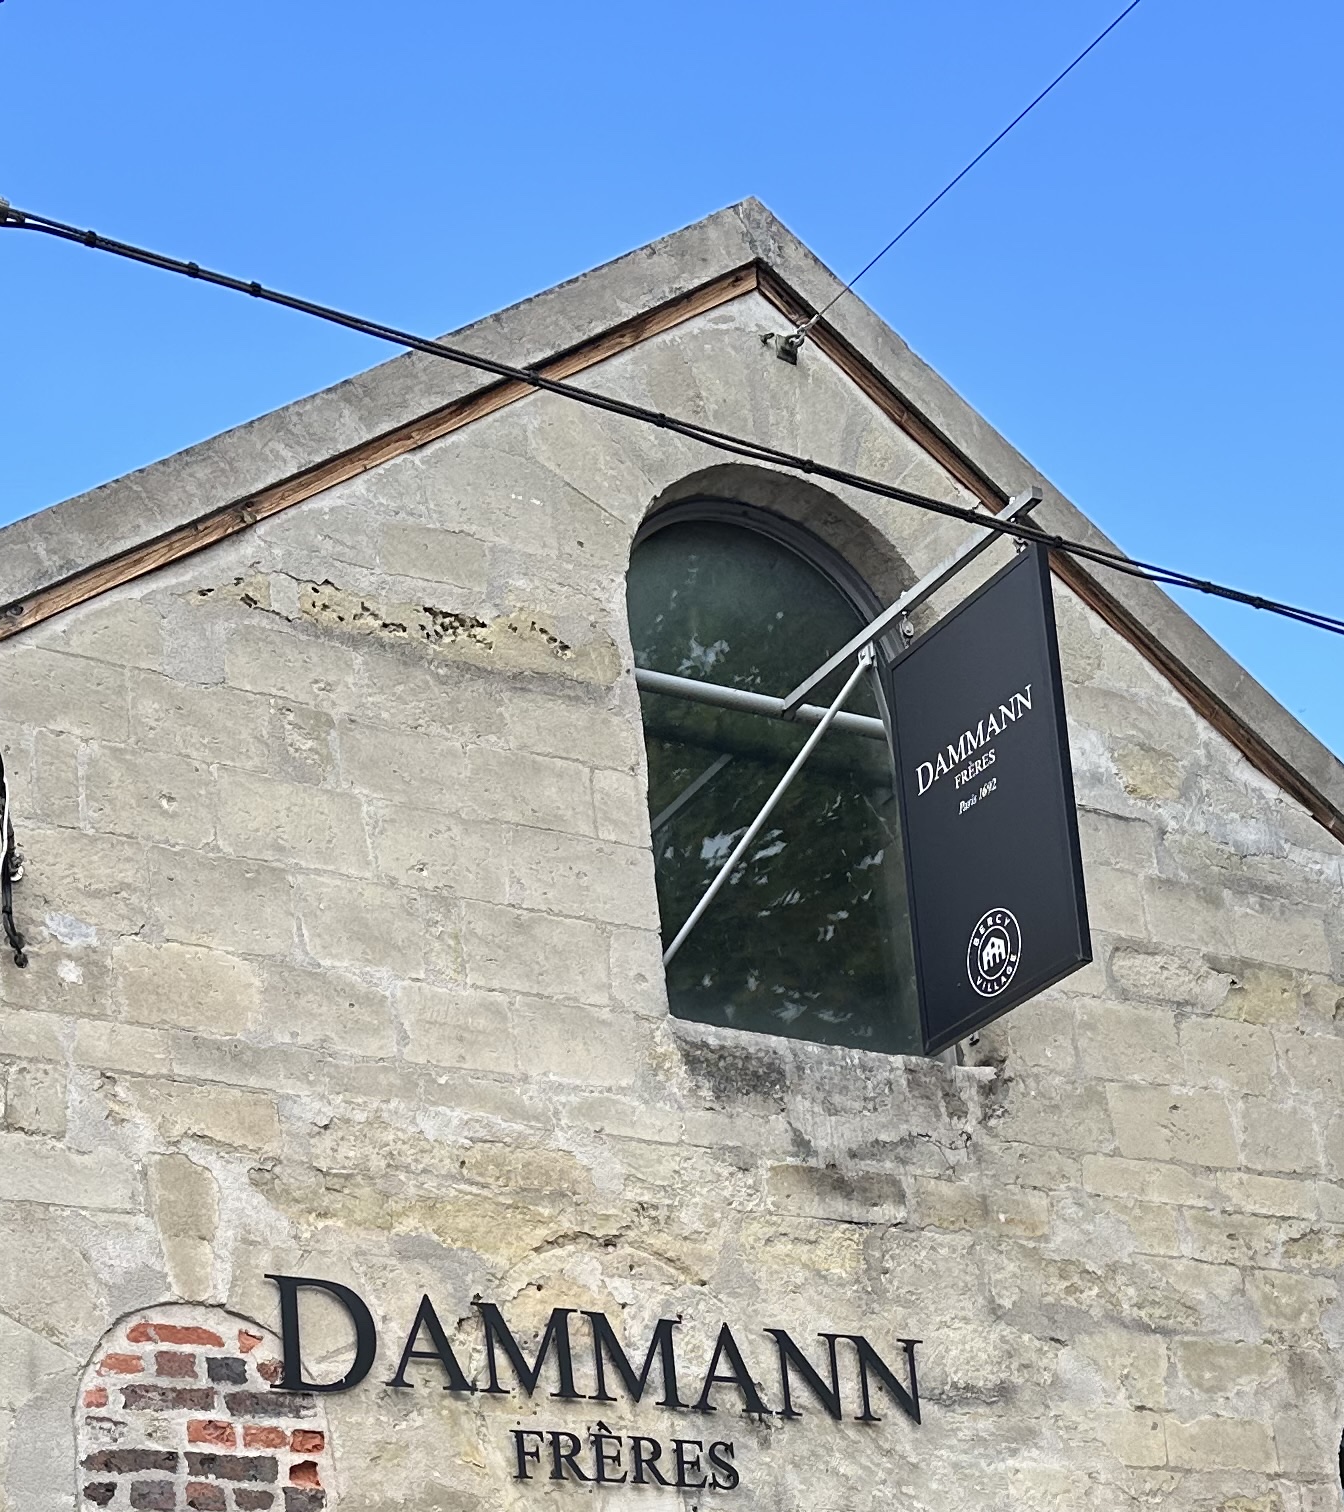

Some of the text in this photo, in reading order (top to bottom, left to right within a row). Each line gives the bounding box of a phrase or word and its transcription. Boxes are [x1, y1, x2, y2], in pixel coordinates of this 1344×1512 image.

[915, 683, 1033, 796] DAMMANN
[954, 748, 996, 789] FRÈRES
[959, 777, 997, 815] Paris 1692
[972, 913, 1011, 947] BERCY
[976, 953, 1017, 992] VILLAGE
[264, 1273, 924, 1426] DAMMANN
[509, 1420, 740, 1491] FRÈRES
